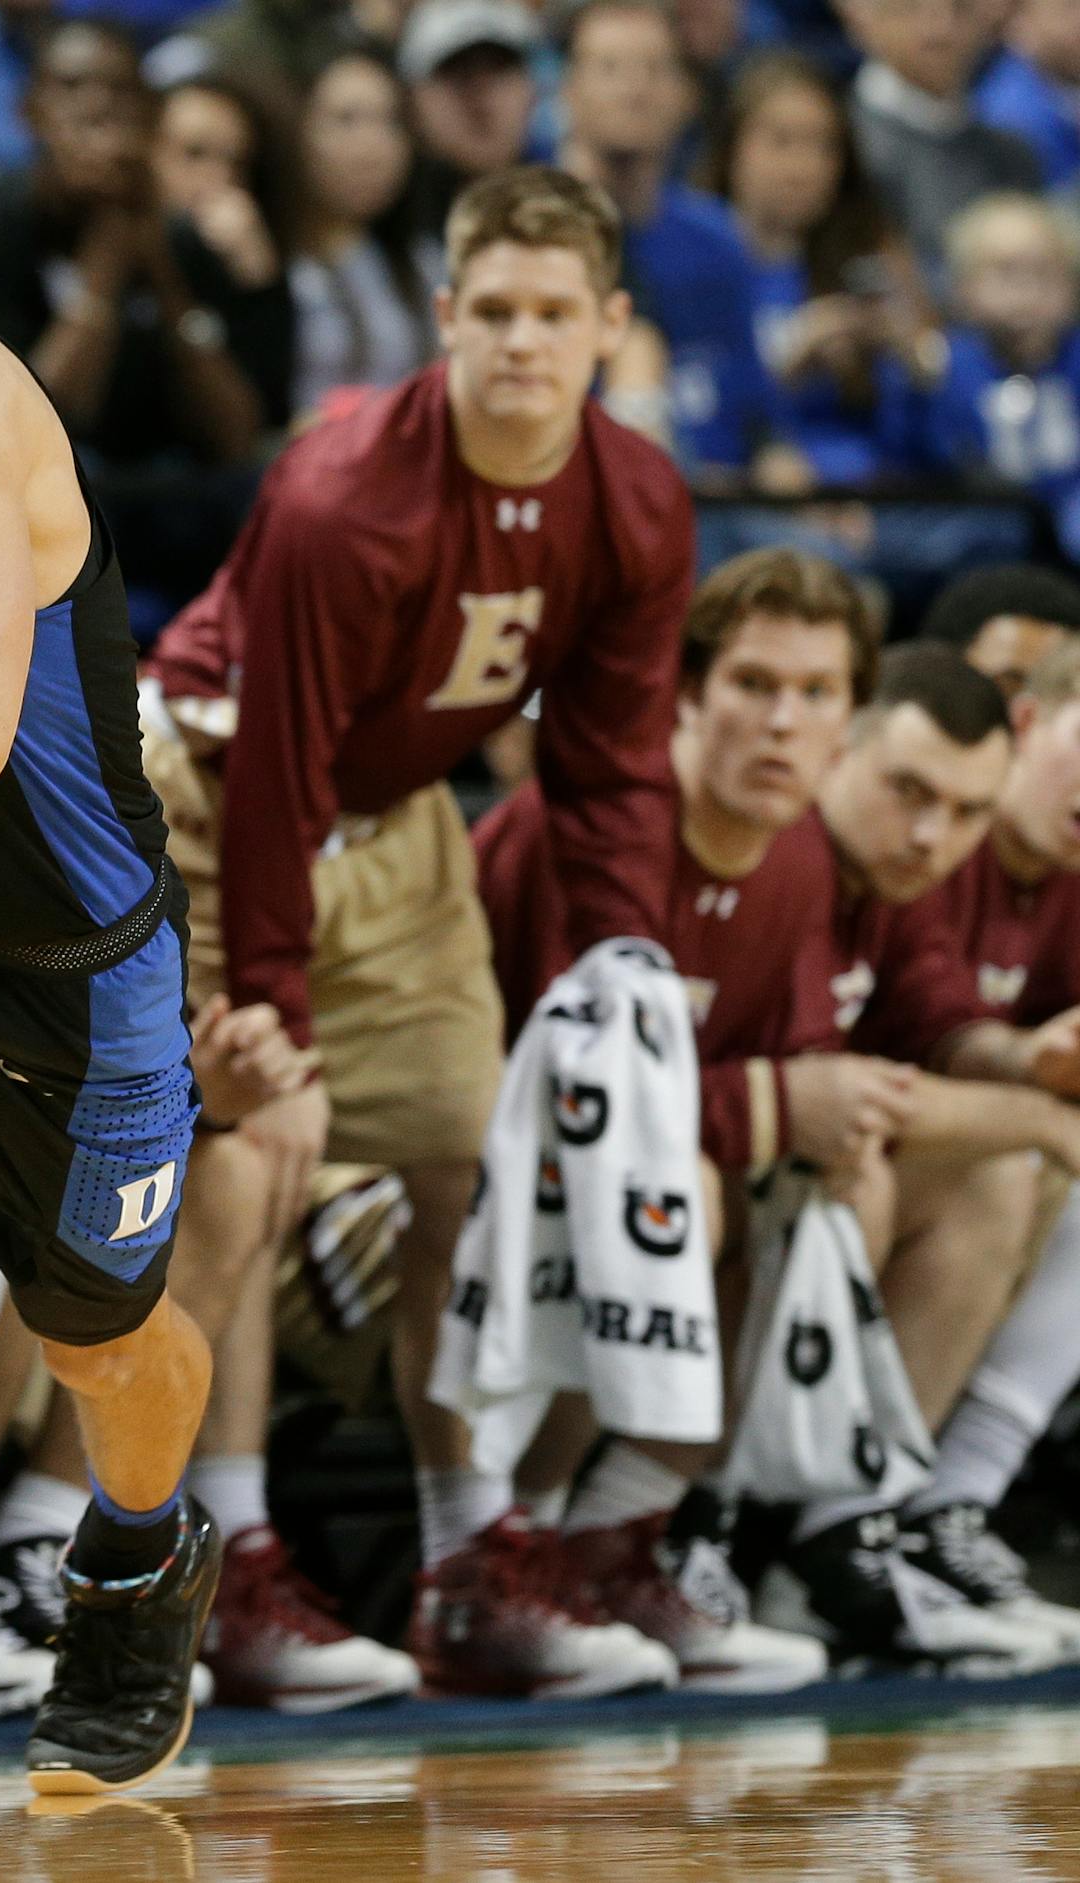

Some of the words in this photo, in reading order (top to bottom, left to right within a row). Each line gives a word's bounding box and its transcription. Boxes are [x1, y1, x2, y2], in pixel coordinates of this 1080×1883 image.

[425, 586, 545, 711] E
[108, 1161, 176, 1241] D
[625, 1183, 689, 1259] G
